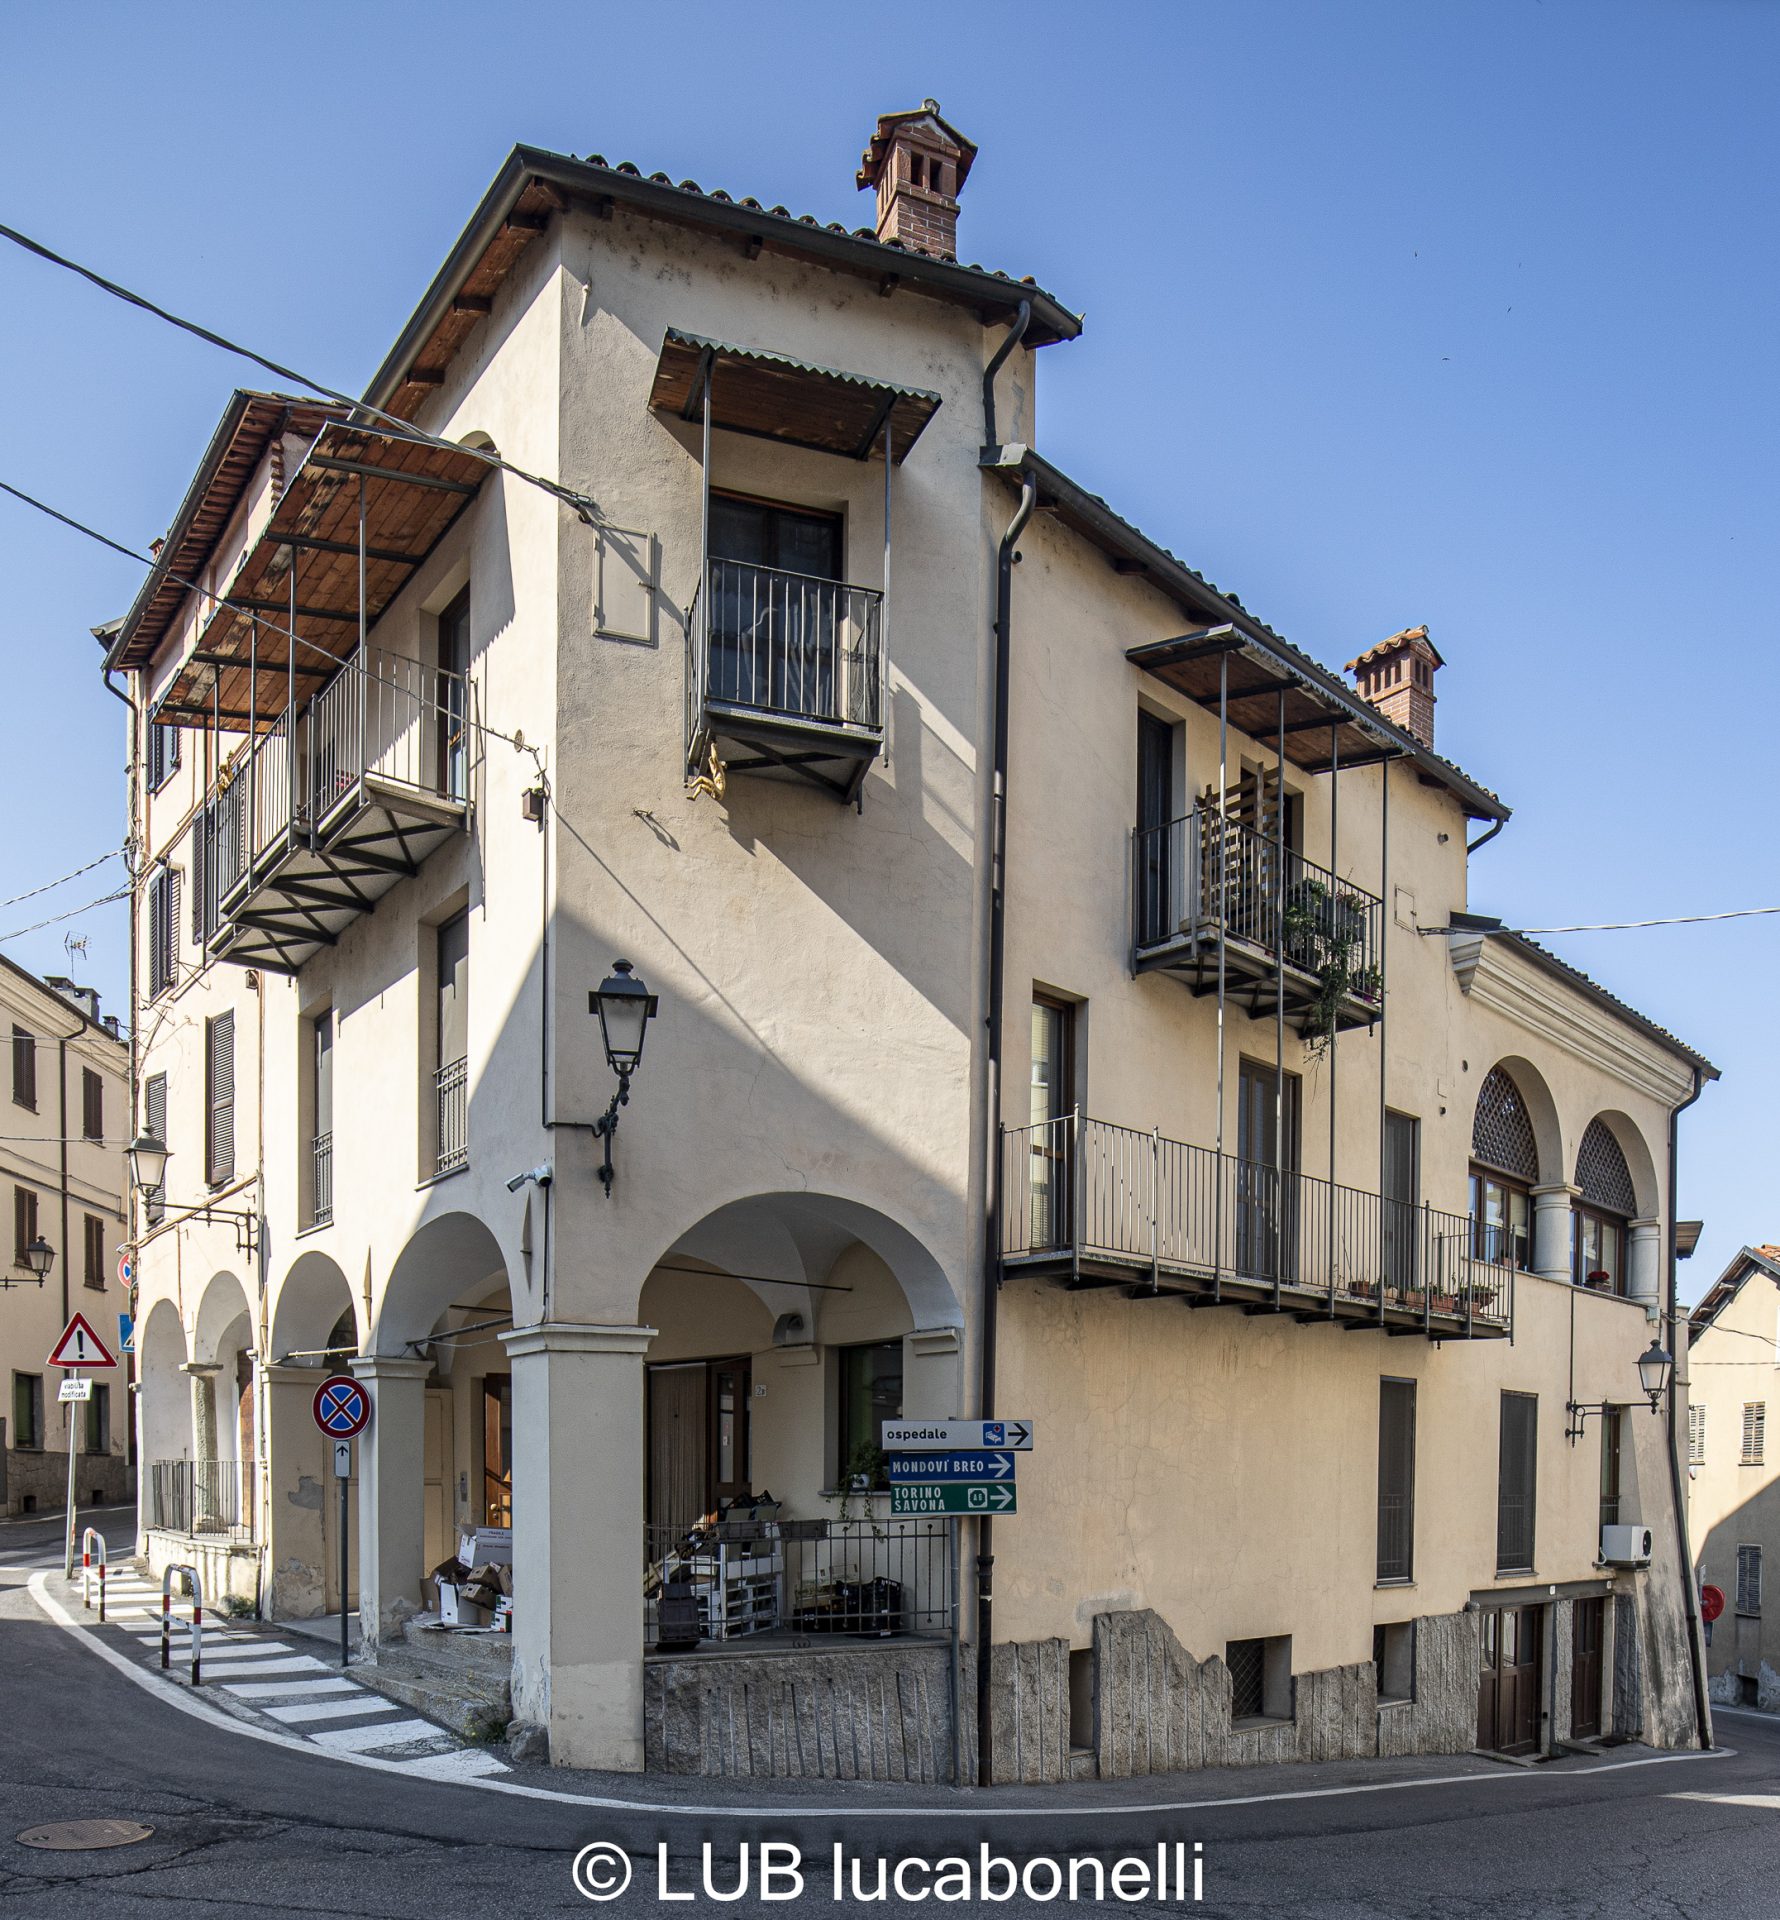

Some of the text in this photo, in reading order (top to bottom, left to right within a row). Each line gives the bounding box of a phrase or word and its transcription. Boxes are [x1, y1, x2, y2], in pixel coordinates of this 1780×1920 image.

[887, 1428, 947, 1441] ospedale
[954, 1460, 984, 1472] BREO
[894, 1487, 941, 1499] TORINO
[895, 1499, 945, 1511] SAVONA
